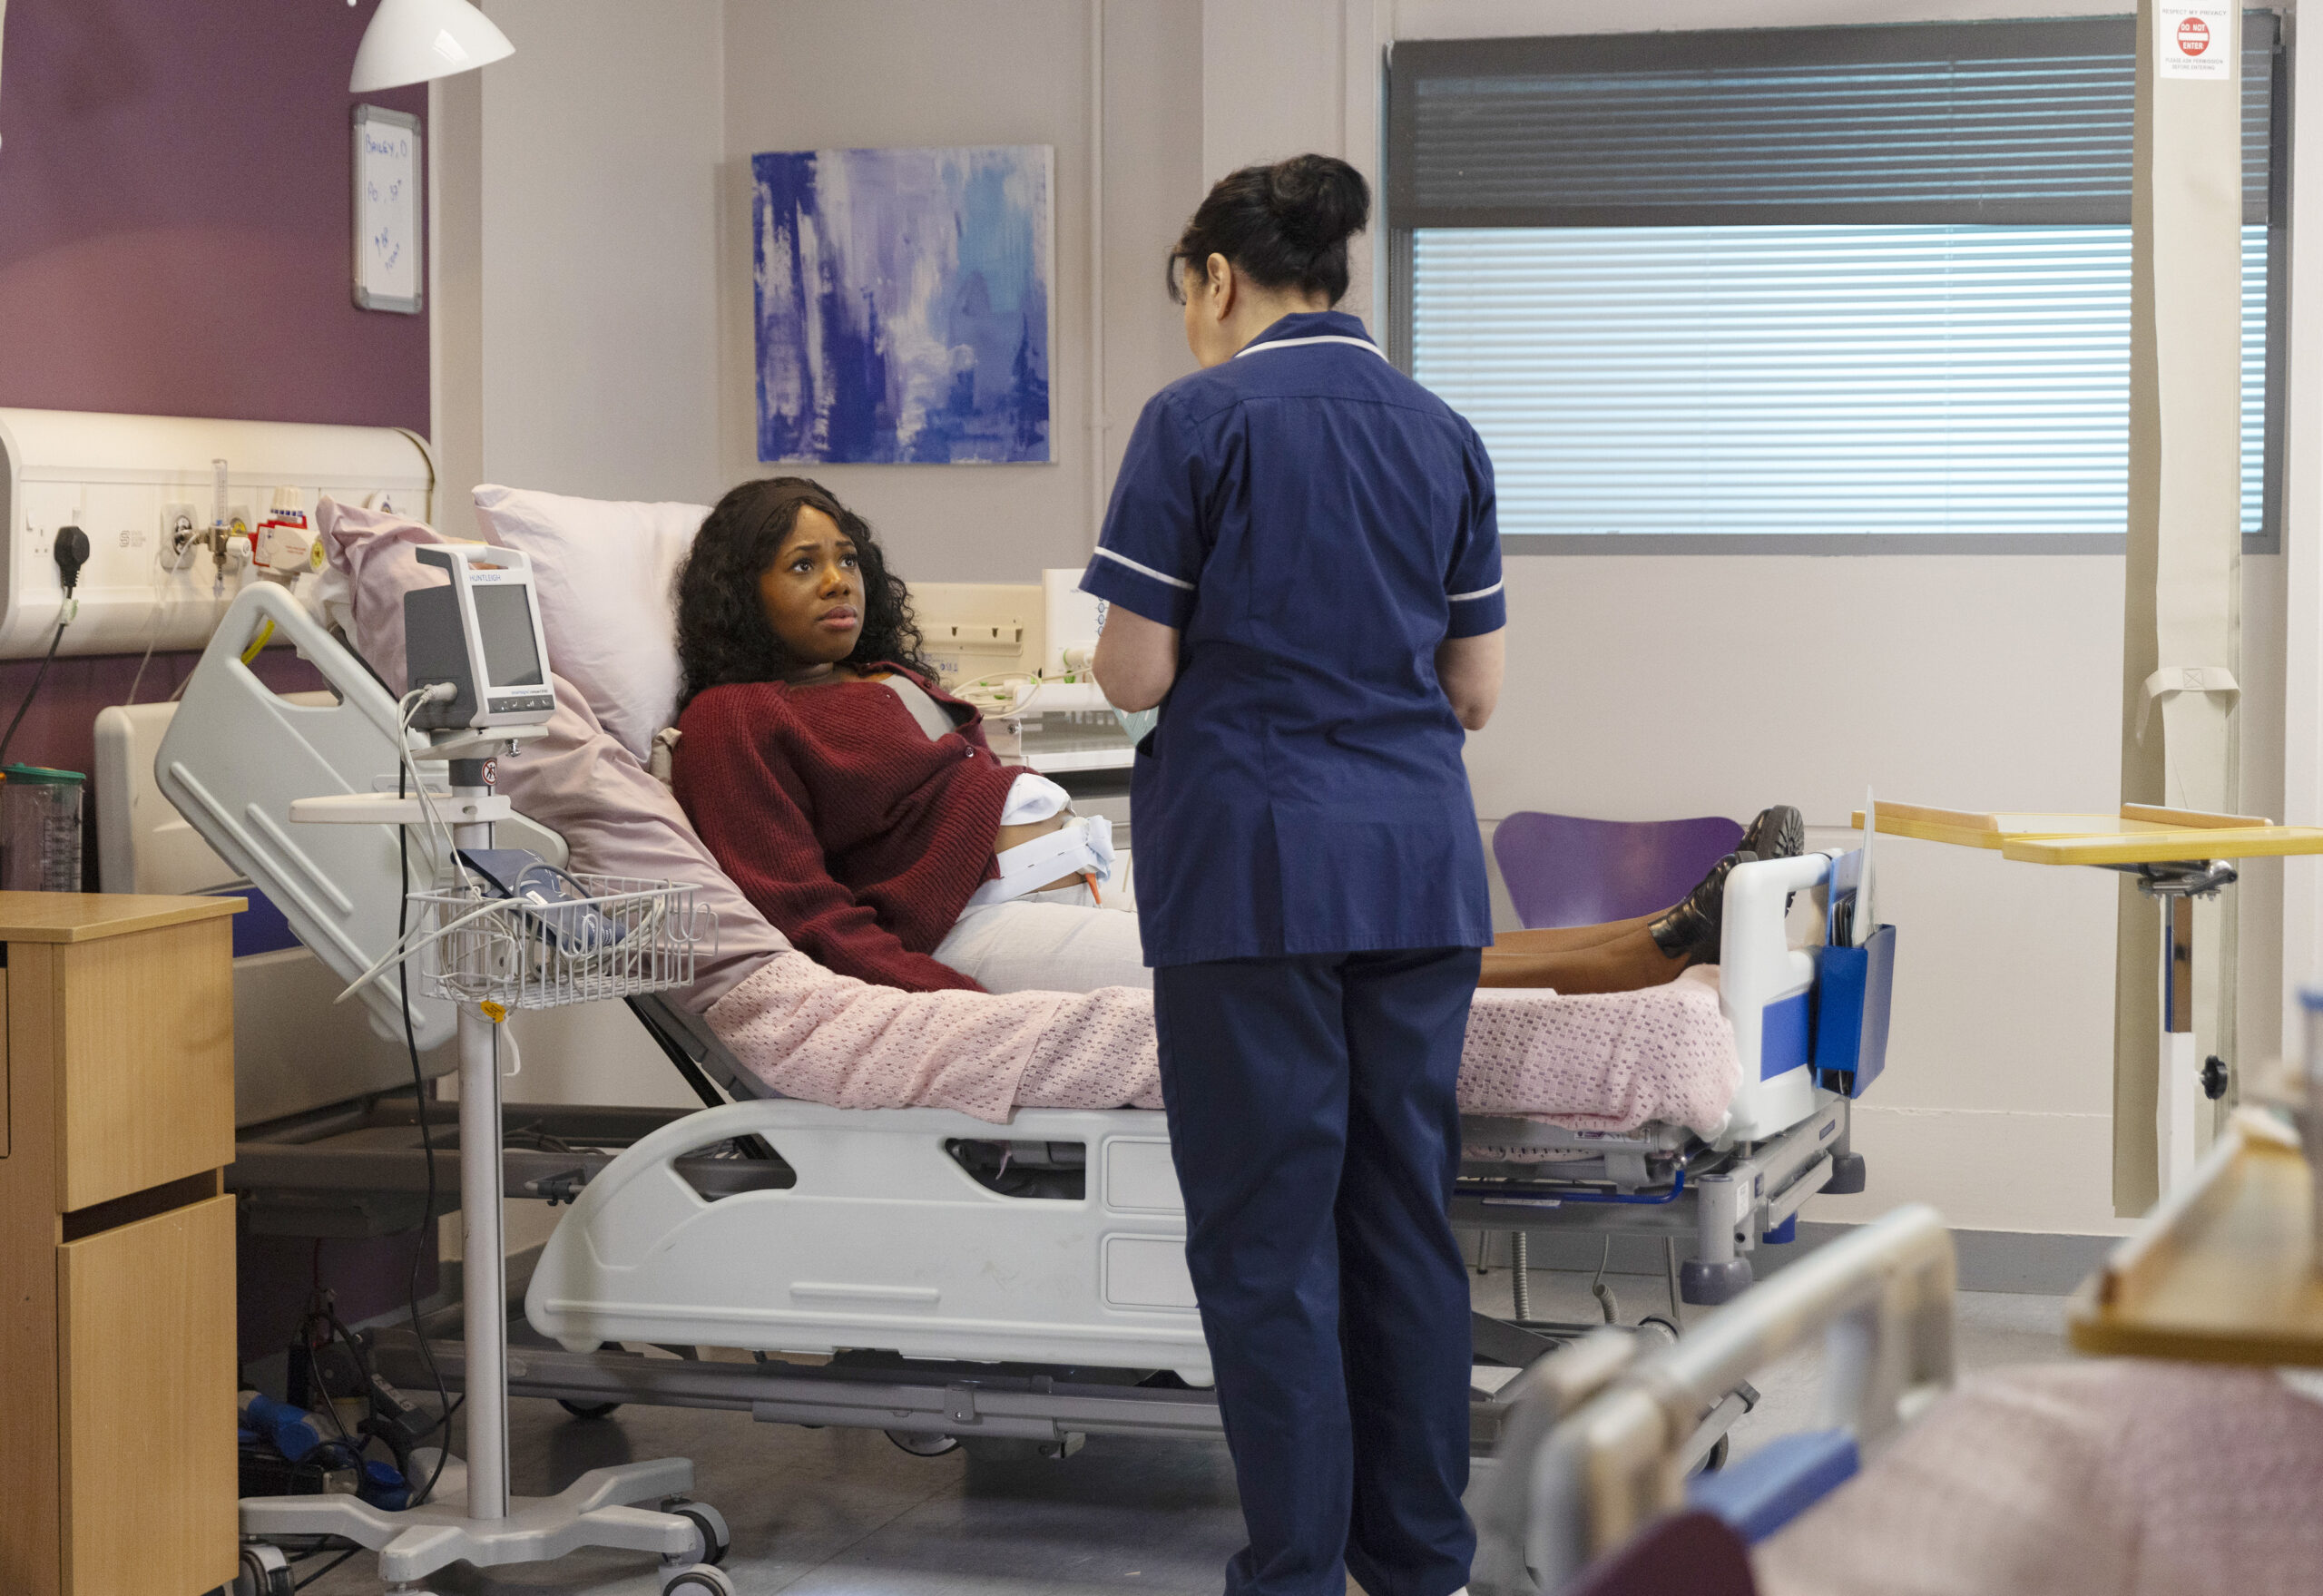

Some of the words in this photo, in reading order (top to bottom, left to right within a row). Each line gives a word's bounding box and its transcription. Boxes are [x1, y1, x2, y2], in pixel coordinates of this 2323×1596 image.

[2181, 23, 2191, 32] DO
[2192, 23, 2206, 32] NOT
[2182, 41, 2204, 50] ENTER
[469, 573, 502, 582] HUNTLEIGH
